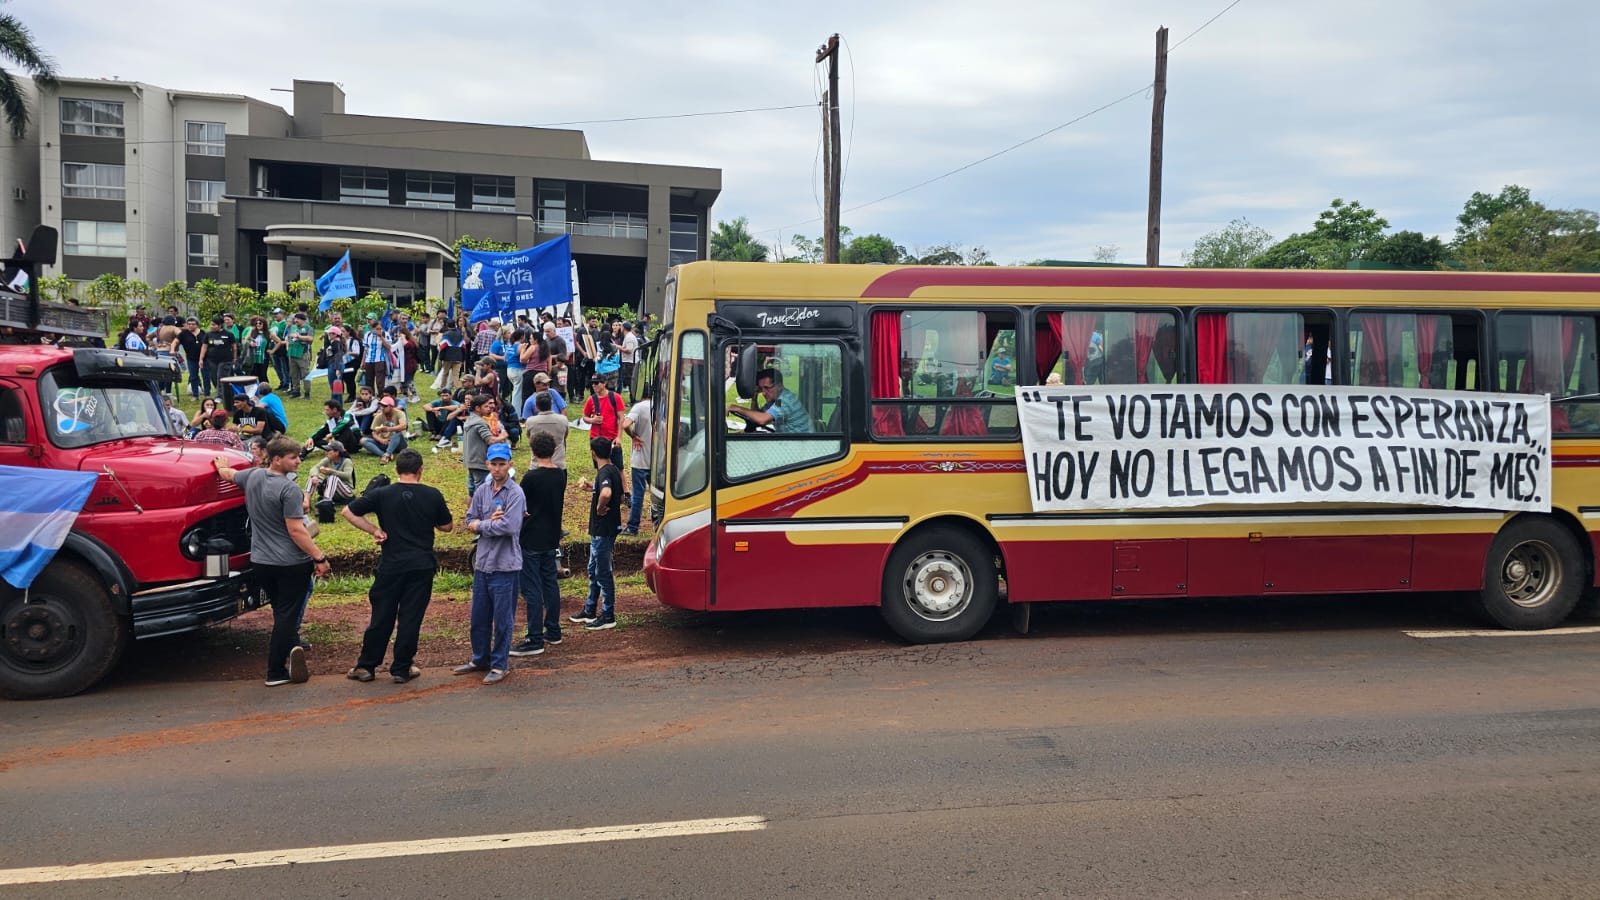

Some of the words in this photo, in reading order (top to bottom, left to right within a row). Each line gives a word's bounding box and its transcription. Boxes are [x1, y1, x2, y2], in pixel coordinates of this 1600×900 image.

[494, 267, 533, 286] Evita
[84, 395, 98, 418] 2023
[1106, 392, 1274, 440] VOTAMOS
[1281, 393, 1341, 438] CON
[1347, 395, 1537, 448] ESPERANZA,
[1033, 451, 1099, 501] HOY
[1110, 449, 1155, 498] NO
[1167, 445, 1362, 496] LLEGAMOS
[1368, 446, 1390, 492] A
[1387, 446, 1439, 495] FIN
[1445, 449, 1480, 499] DE
